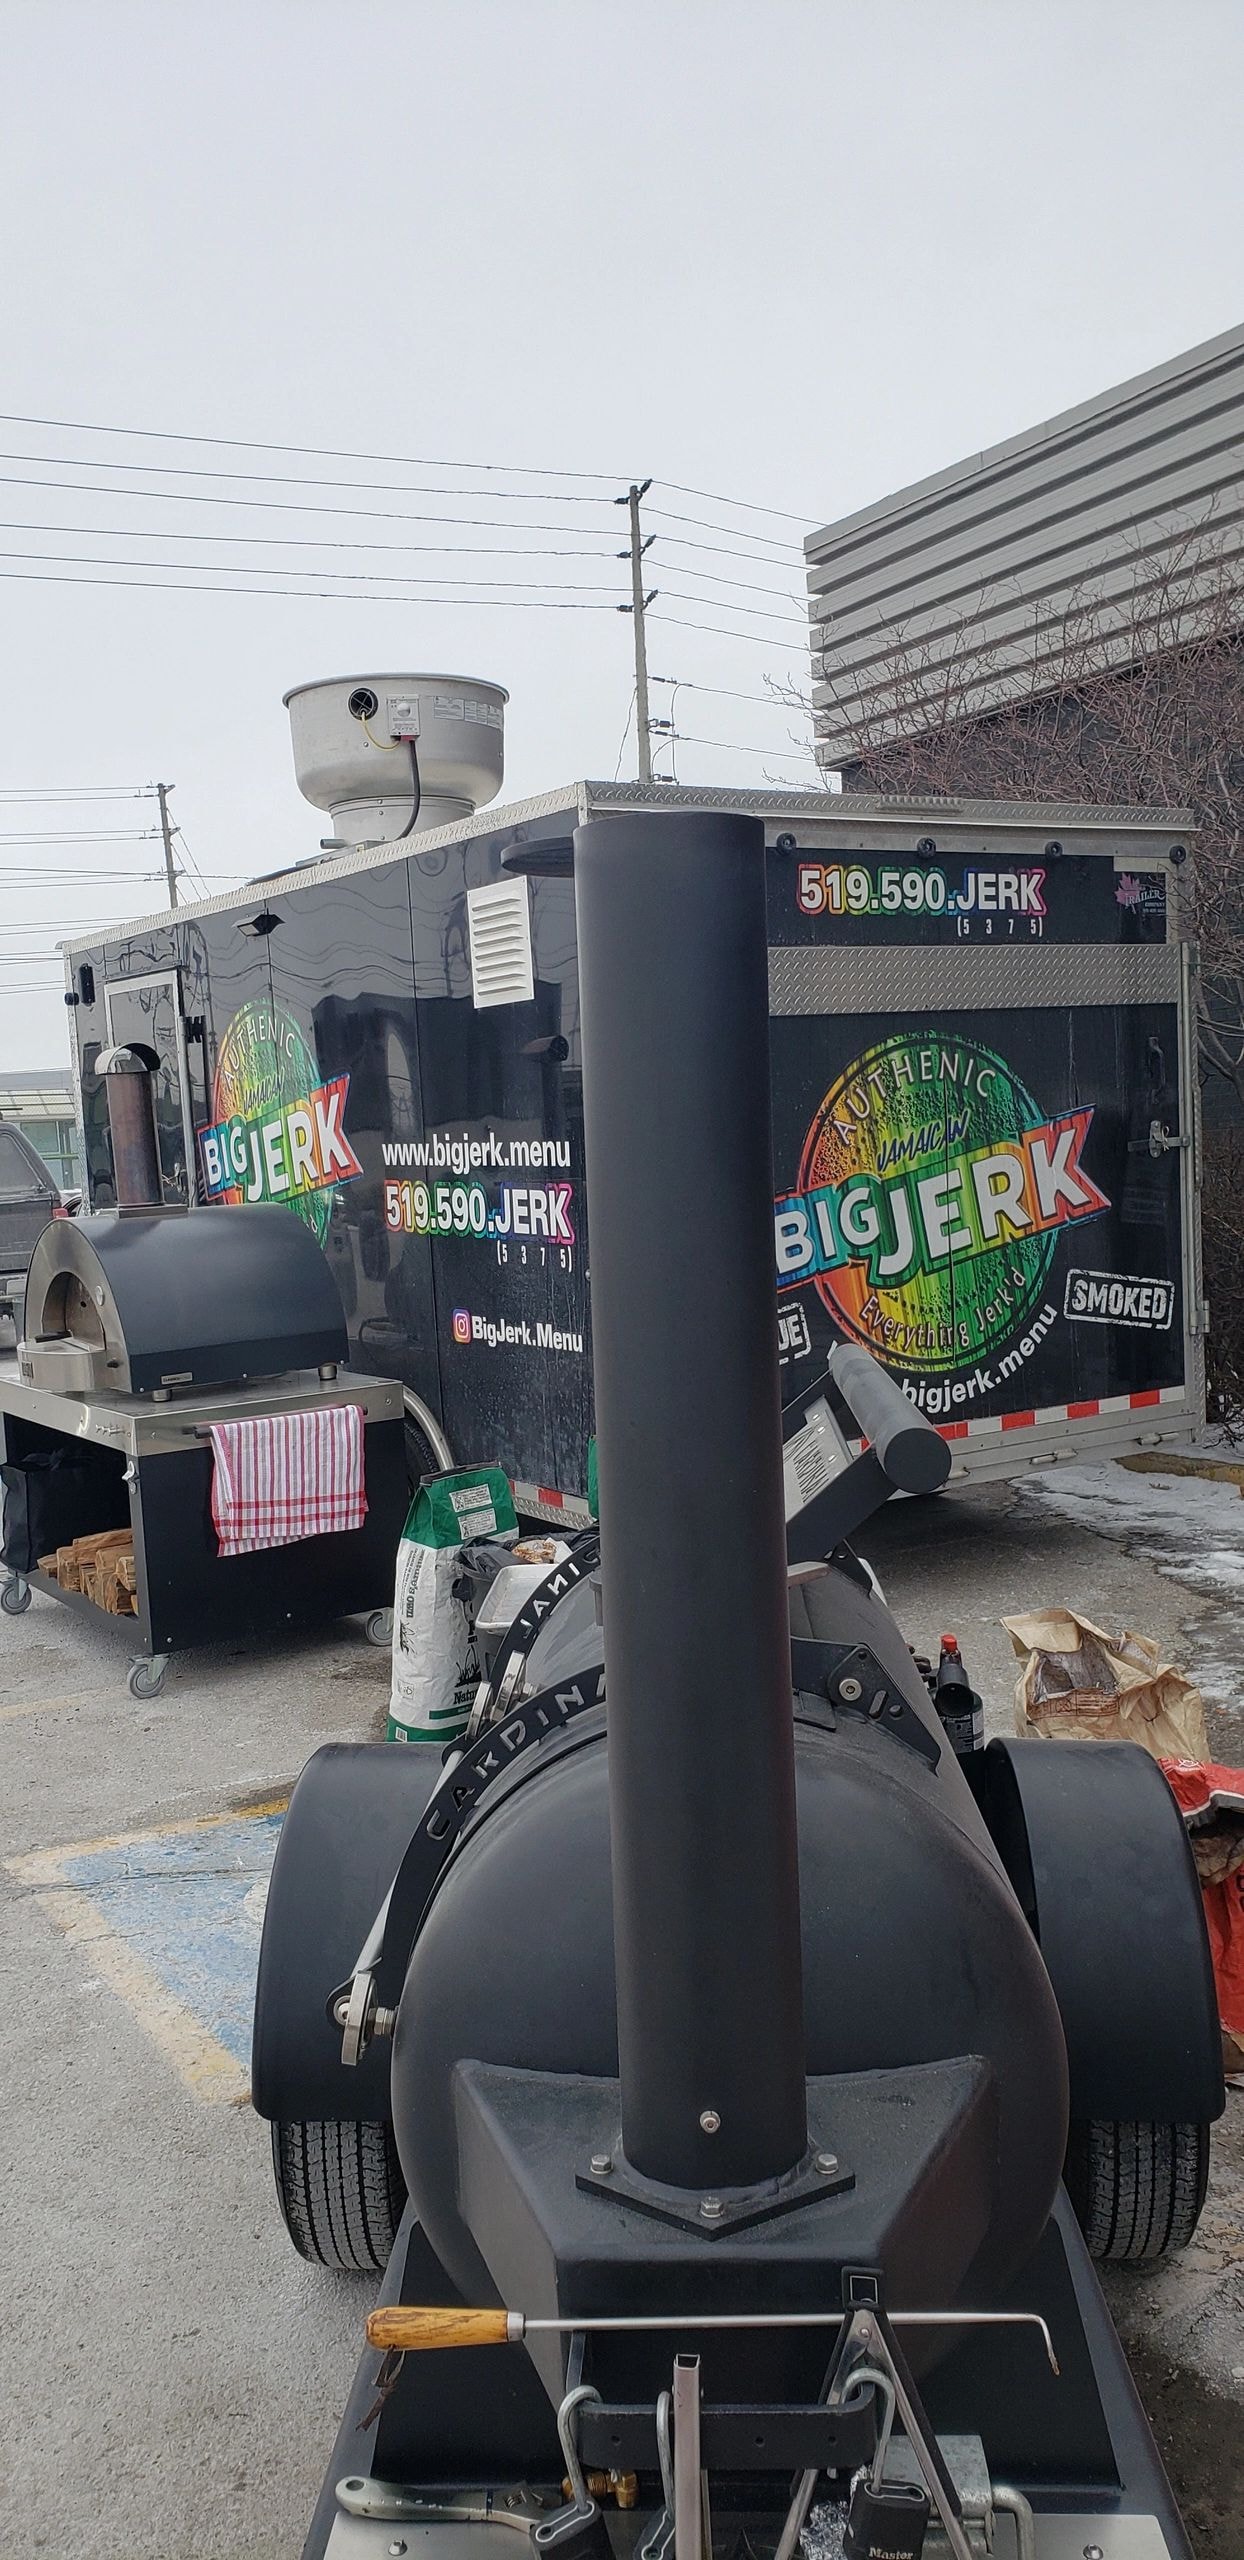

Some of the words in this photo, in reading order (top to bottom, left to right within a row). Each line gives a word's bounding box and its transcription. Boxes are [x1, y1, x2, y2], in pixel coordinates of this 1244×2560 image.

[799, 869, 1044, 912] 519.590.JERK
[222, 1015, 295, 1091] AUTHENIC
[832, 1050, 996, 1145] AUTHENIC
[204, 1133, 247, 1186] BIG
[247, 1093, 352, 1202] JERK
[382, 1133, 571, 1175] www.bigjerk.menu
[385, 1184, 573, 1240] 519.590.JERK
[775, 1187, 881, 1274] BIG
[879, 1128, 1090, 1275] JERK
[859, 1295, 970, 1350] Everything
[1070, 1280, 1169, 1321] SMOKED
[471, 1316, 584, 1354] BigJerk.Menu
[868, 2546, 914, 2560] Master
